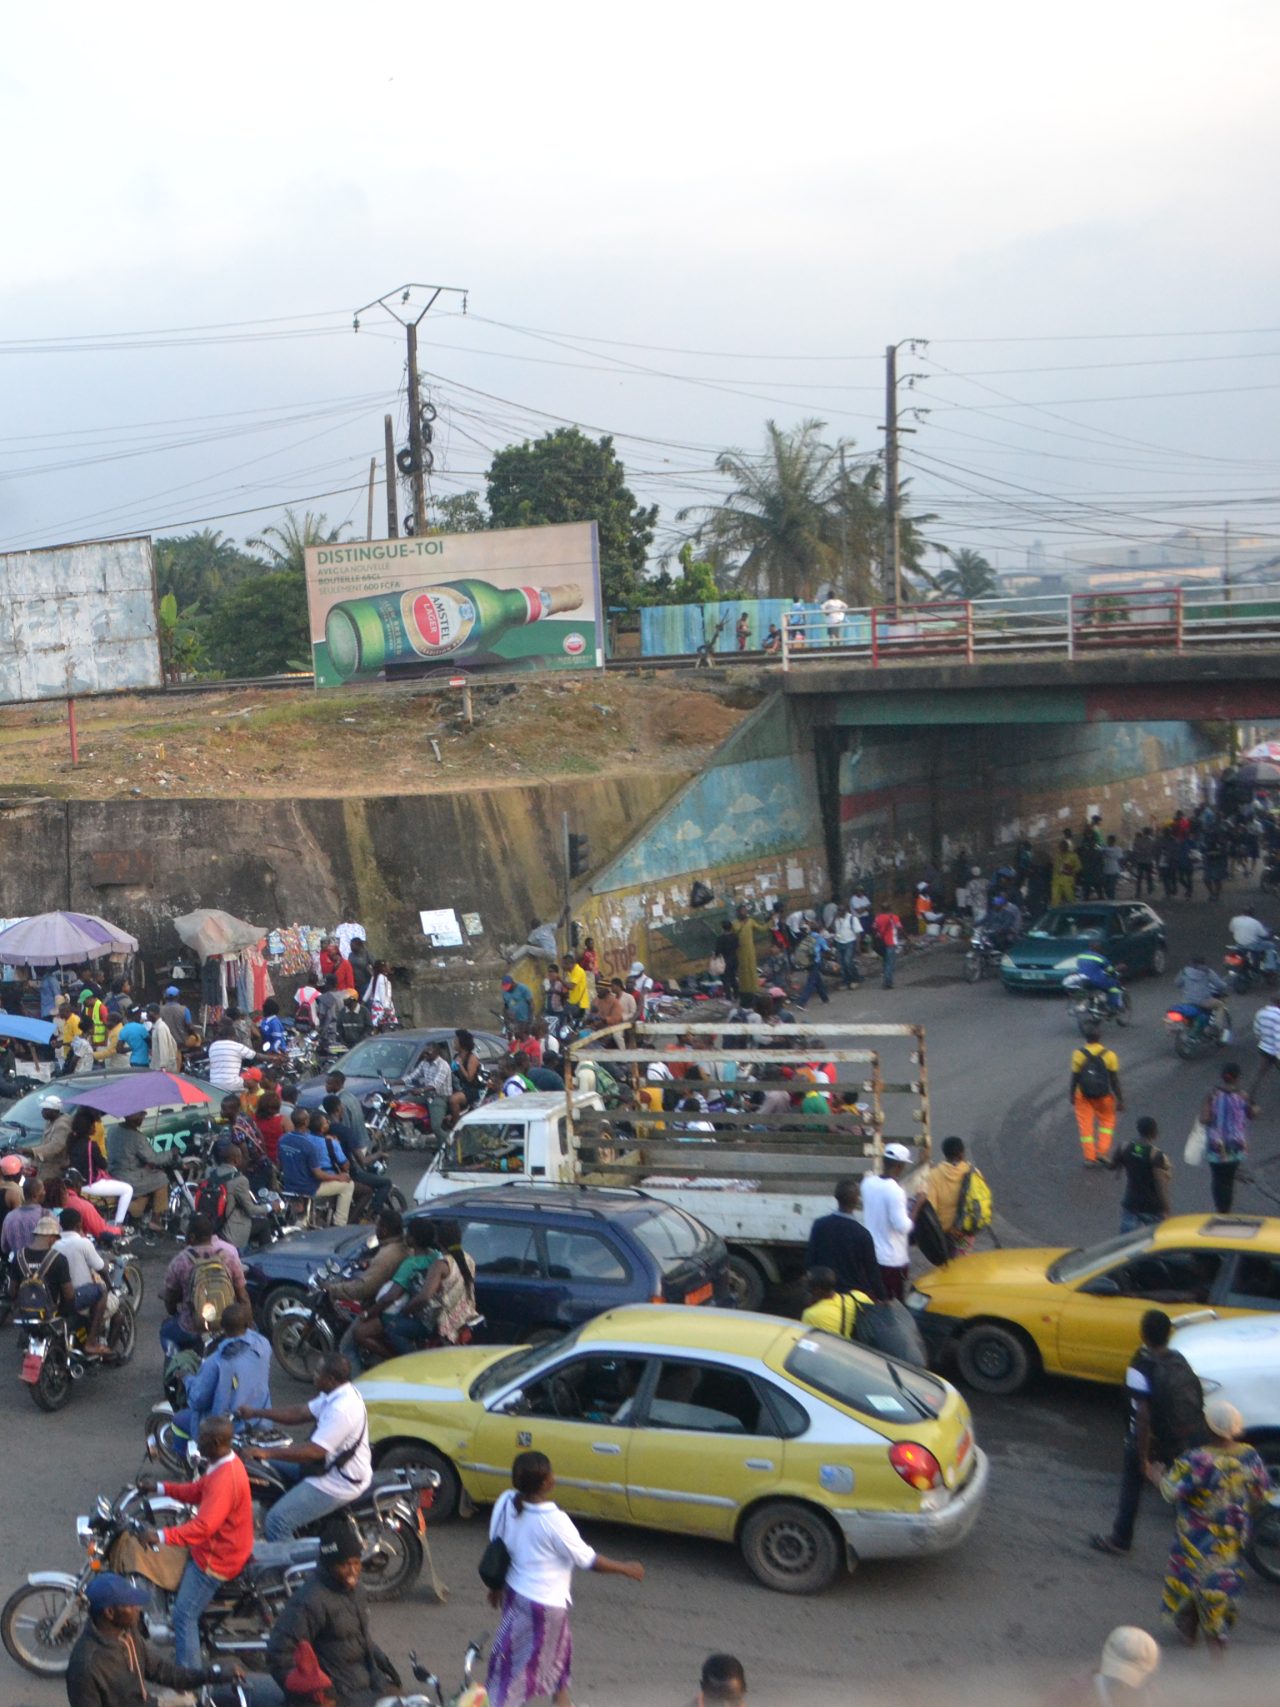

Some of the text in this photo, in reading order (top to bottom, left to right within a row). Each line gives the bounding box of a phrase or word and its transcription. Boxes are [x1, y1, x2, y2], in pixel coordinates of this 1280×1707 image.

[317, 541, 444, 564] DISTINGUE-TOI
[318, 567, 338, 576] AVEC
[350, 563, 390, 573] NOUVELLE
[318, 576, 359, 585] BOUTEILLE
[319, 584, 362, 594] SEULEMENT
[380, 581, 401, 589] FCFA
[423, 603, 438, 633] LAGER
[430, 596, 450, 640] AMSTEL
[604, 944, 636, 976] STOP
